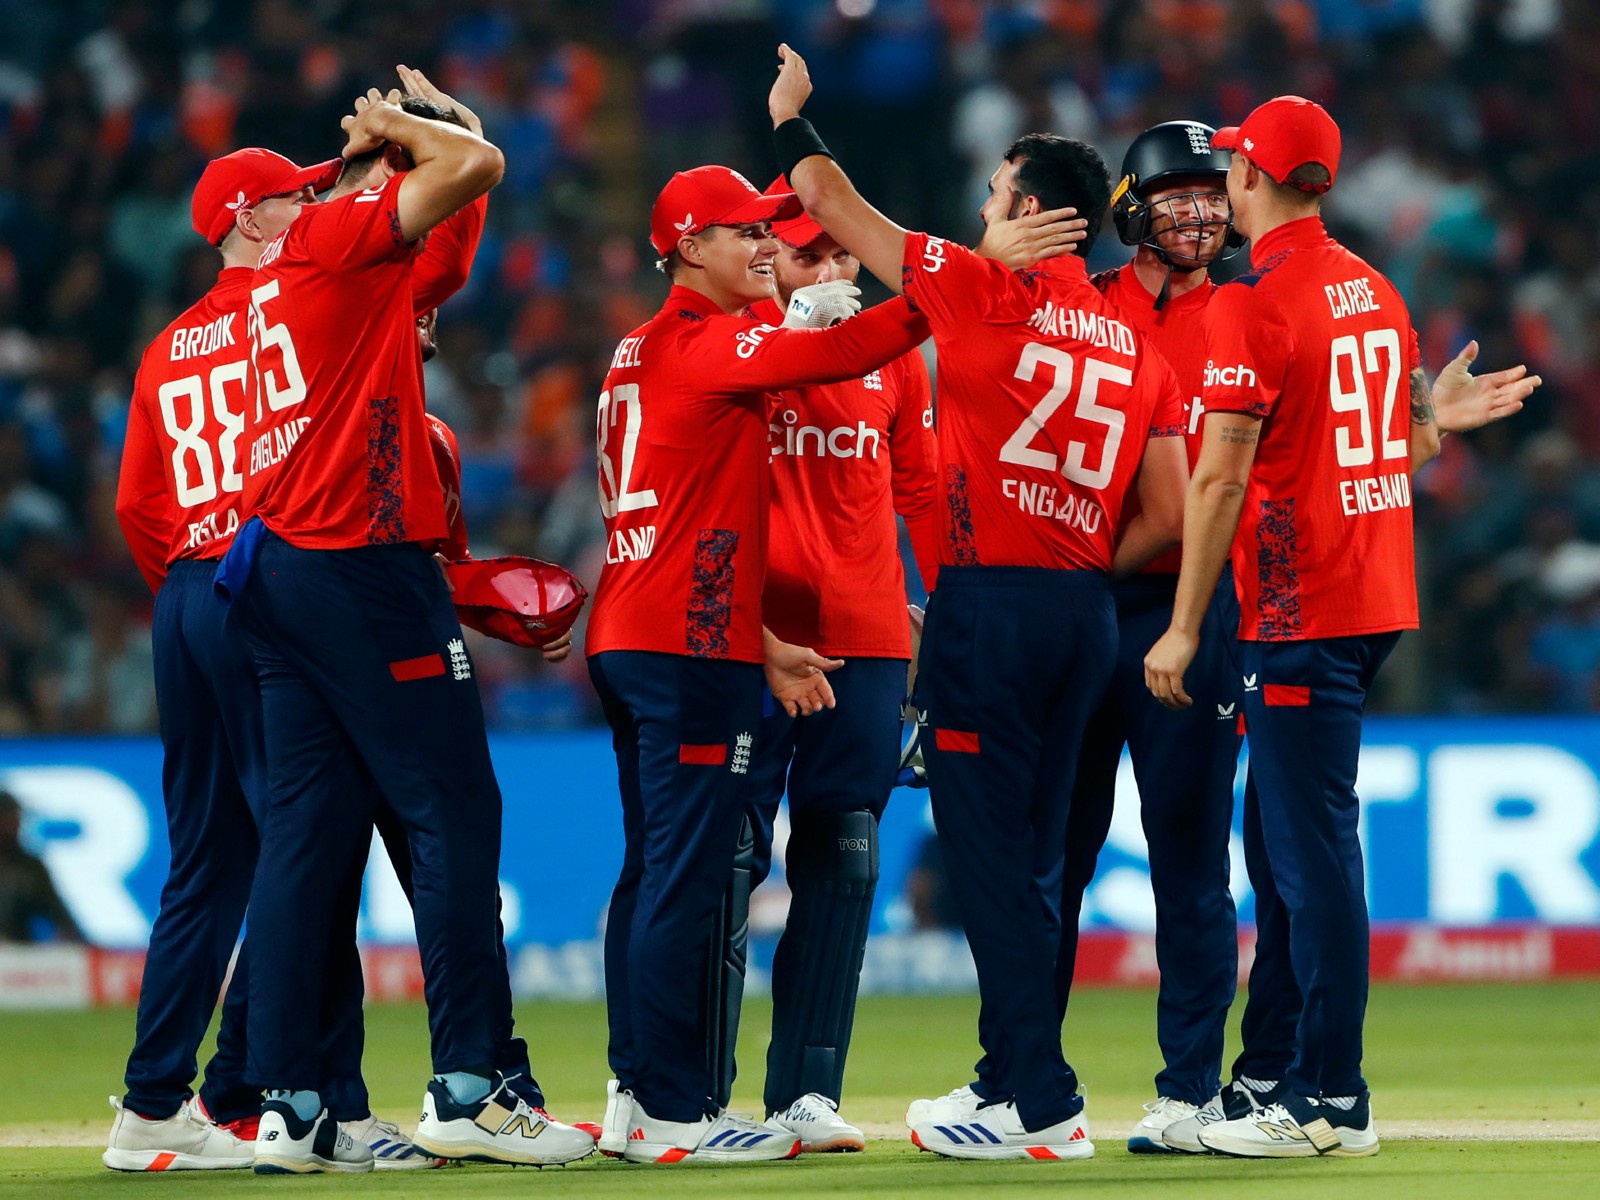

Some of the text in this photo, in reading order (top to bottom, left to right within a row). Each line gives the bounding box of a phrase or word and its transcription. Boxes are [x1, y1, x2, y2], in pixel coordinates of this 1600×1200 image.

[1324, 277, 1380, 319] CARSE
[170, 312, 236, 361] BROOK
[998, 341, 1133, 490] 25
[1329, 328, 1408, 468] 92
[1339, 472, 1411, 517] ENGLAND
[838, 838, 868, 851] TON
